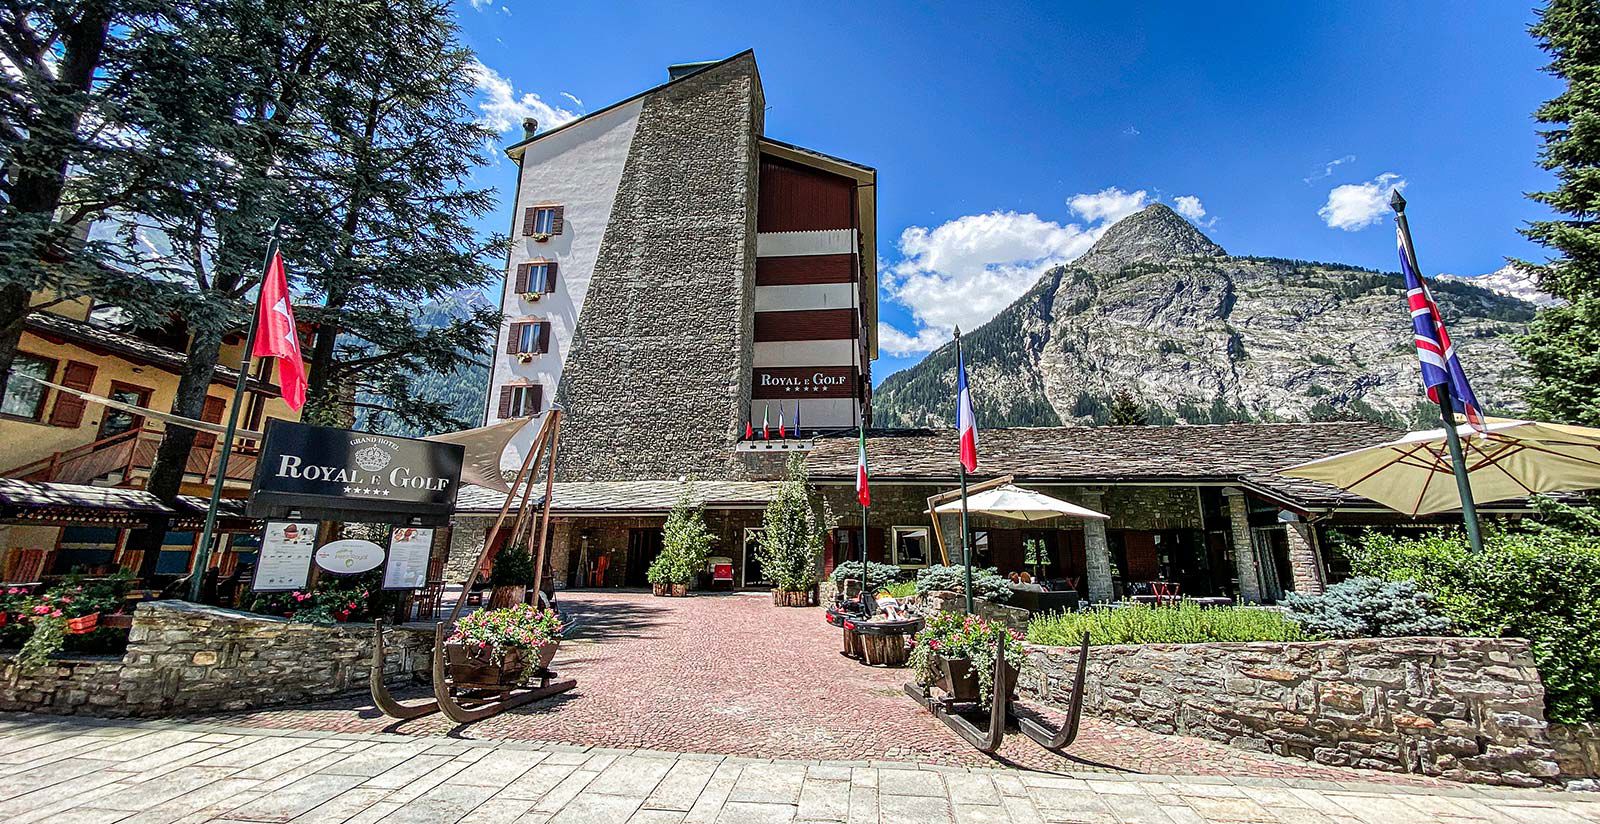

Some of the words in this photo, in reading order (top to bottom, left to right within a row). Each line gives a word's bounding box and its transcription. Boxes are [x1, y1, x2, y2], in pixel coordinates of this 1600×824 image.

[761, 373, 801, 385] ROYAL
[812, 372, 846, 385] GOLF
[350, 437, 378, 446] GRAND
[378, 438, 400, 452] HOTEL
[275, 454, 364, 484] ROYAL
[371, 475, 381, 485] E
[389, 466, 449, 491] GOLF
